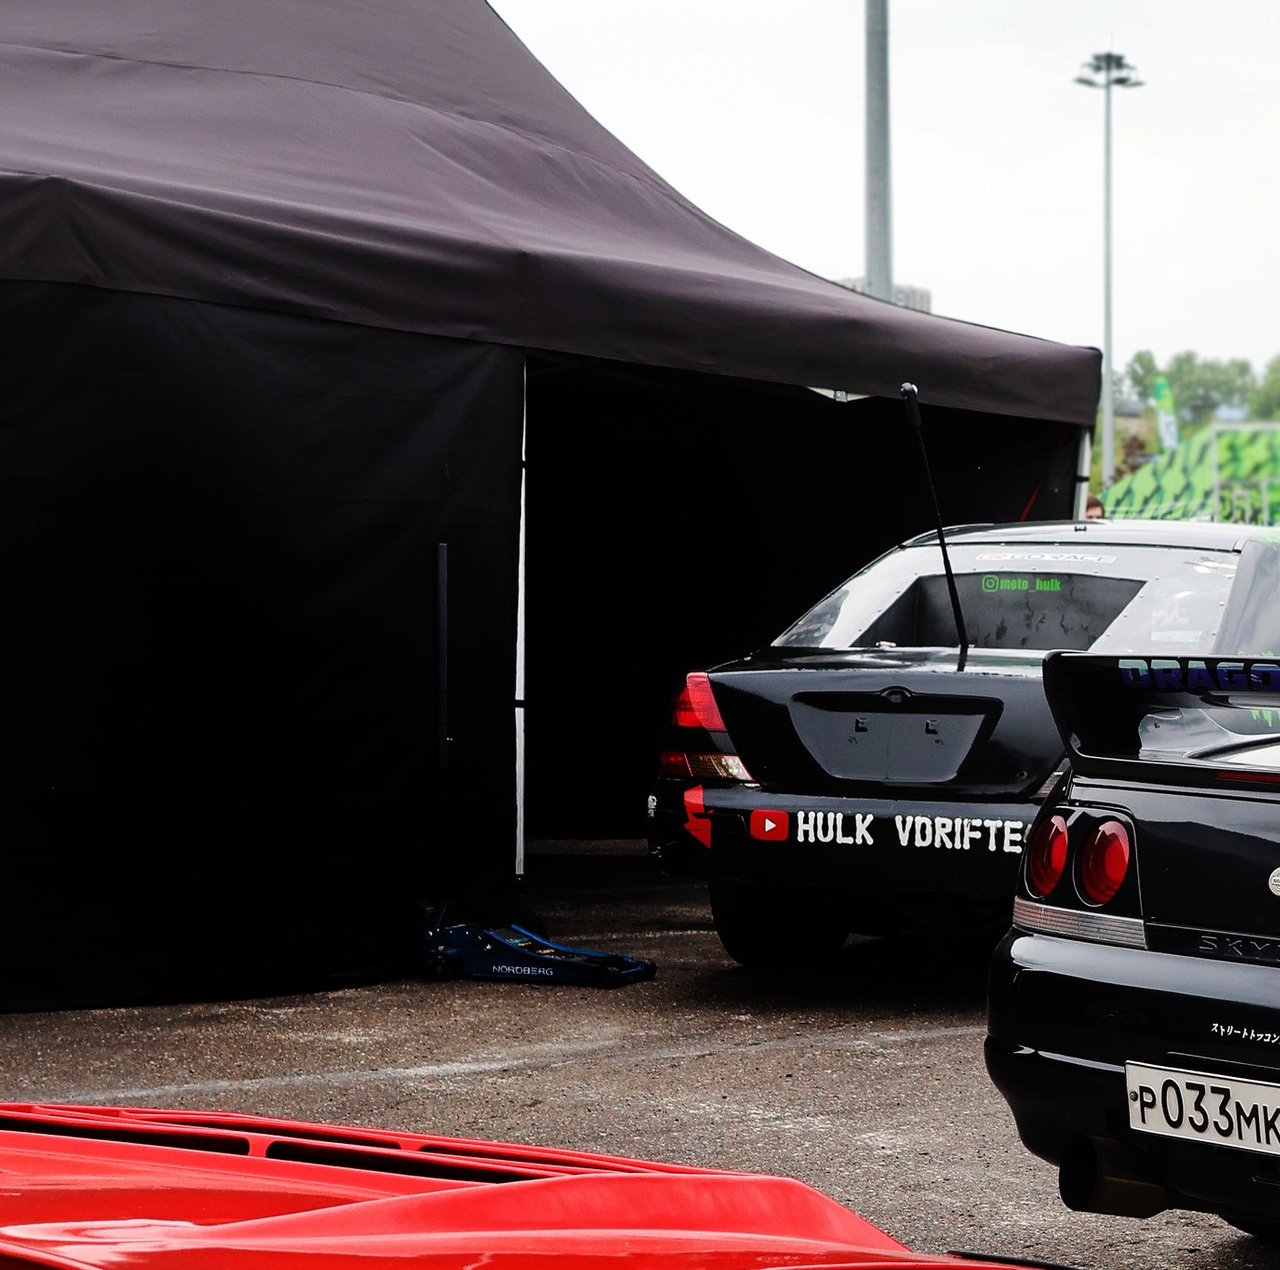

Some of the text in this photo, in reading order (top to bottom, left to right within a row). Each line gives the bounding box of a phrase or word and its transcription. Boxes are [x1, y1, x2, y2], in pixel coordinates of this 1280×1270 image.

[1000, 577, 1061, 593] moto_hulk
[797, 811, 1031, 853] HULK VDRIFTE
[492, 965, 554, 976] NORDBERG
